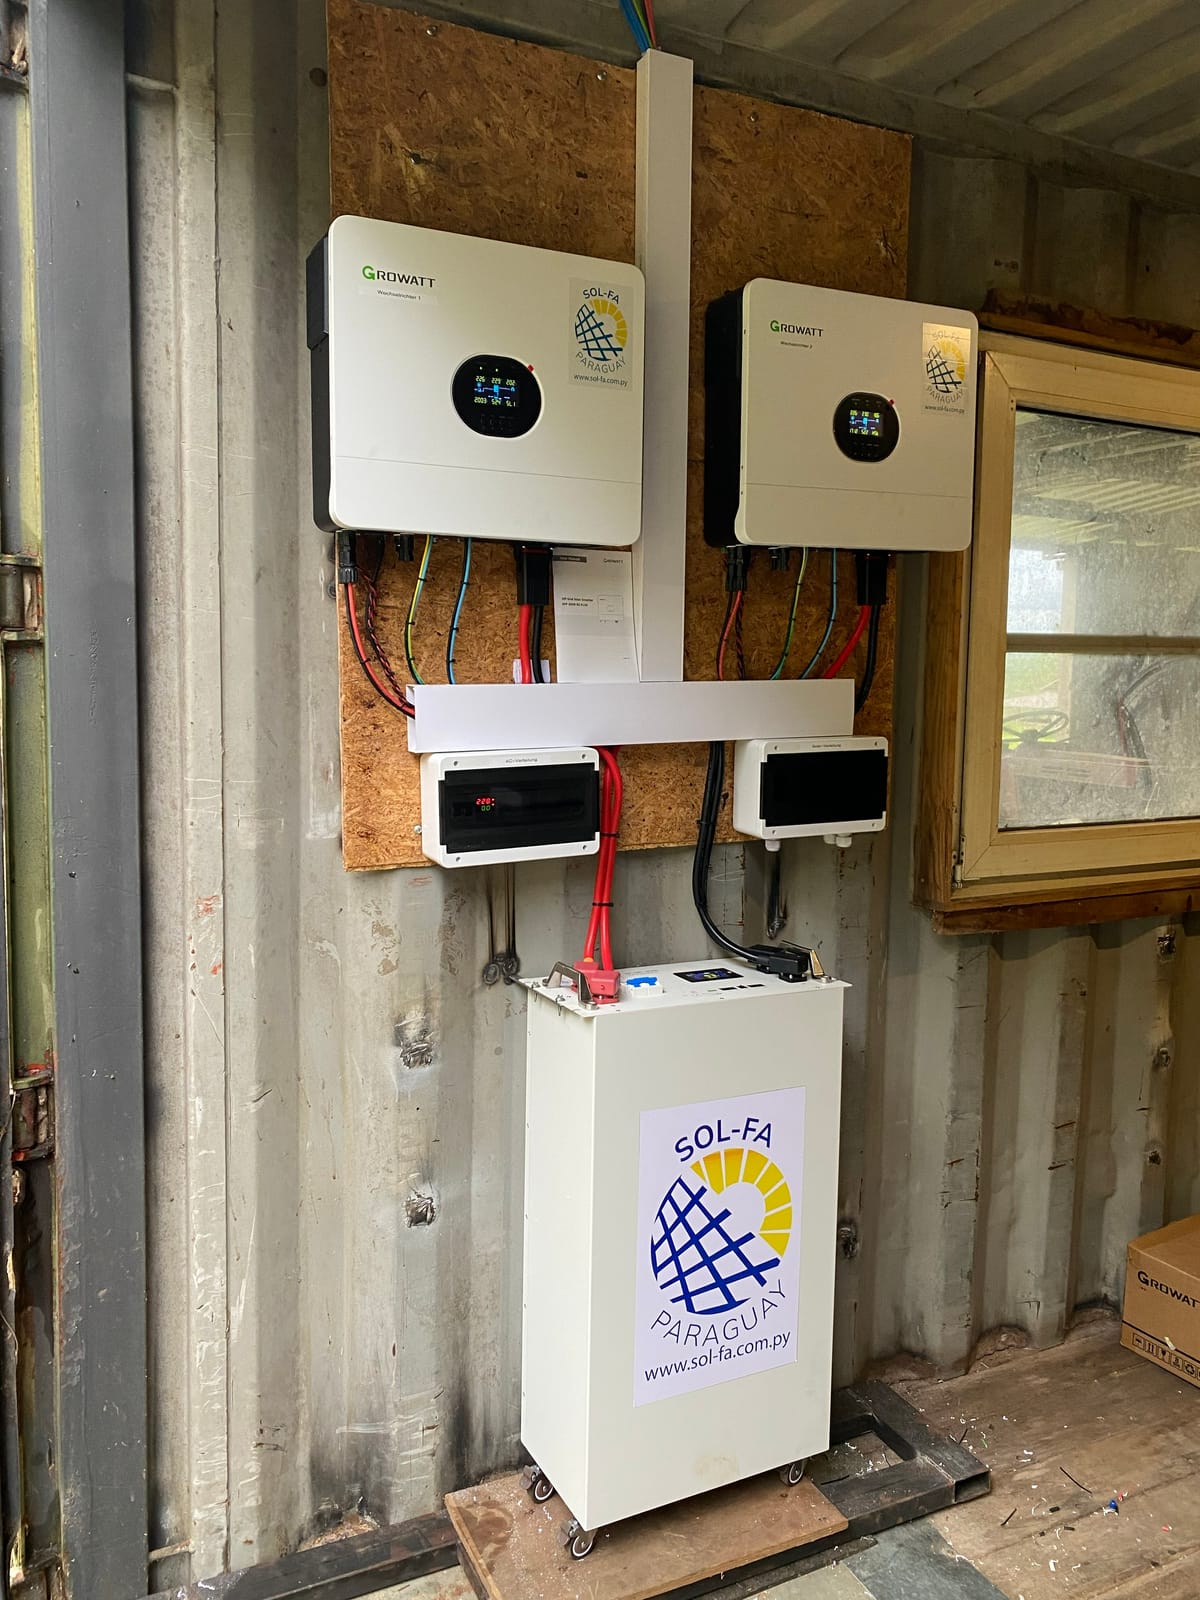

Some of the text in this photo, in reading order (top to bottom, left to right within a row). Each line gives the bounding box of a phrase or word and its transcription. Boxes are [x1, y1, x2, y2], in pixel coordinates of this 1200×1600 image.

[362, 265, 436, 288] GROWATT
[583, 287, 620, 304] SOL-FA
[770, 320, 824, 337] GROWATT
[575, 351, 626, 374] PARAGUAY
[574, 374, 628, 387] www.sol-fa.com.py
[674, 1117, 773, 1162] SOL-FA
[1137, 1270, 1200, 1308] GROWAT
[651, 1279, 786, 1347] PARAGUAY
[644, 1331, 791, 1382] www.sol-fa.com.py
